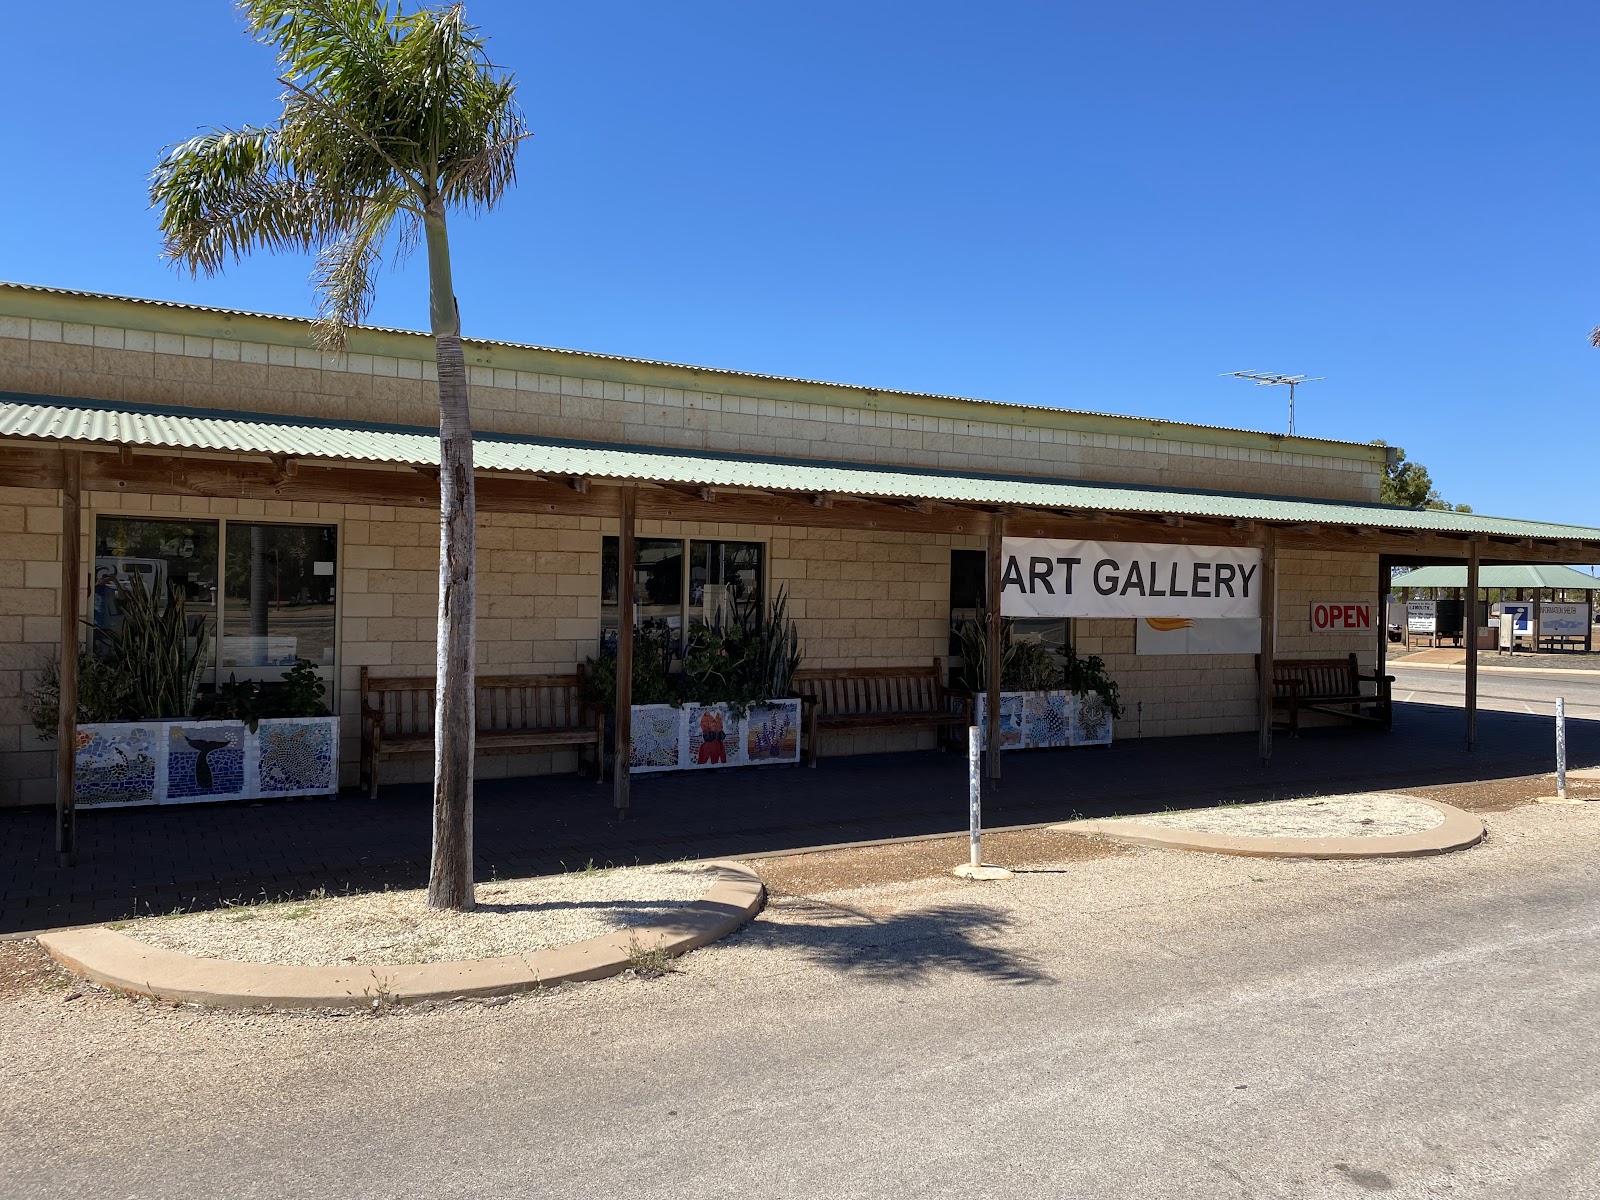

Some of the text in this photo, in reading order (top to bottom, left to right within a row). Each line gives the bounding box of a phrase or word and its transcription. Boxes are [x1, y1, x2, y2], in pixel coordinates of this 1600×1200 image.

[1001, 555, 1258, 598] ART GALLERY
[1314, 604, 1370, 629] OPEN
